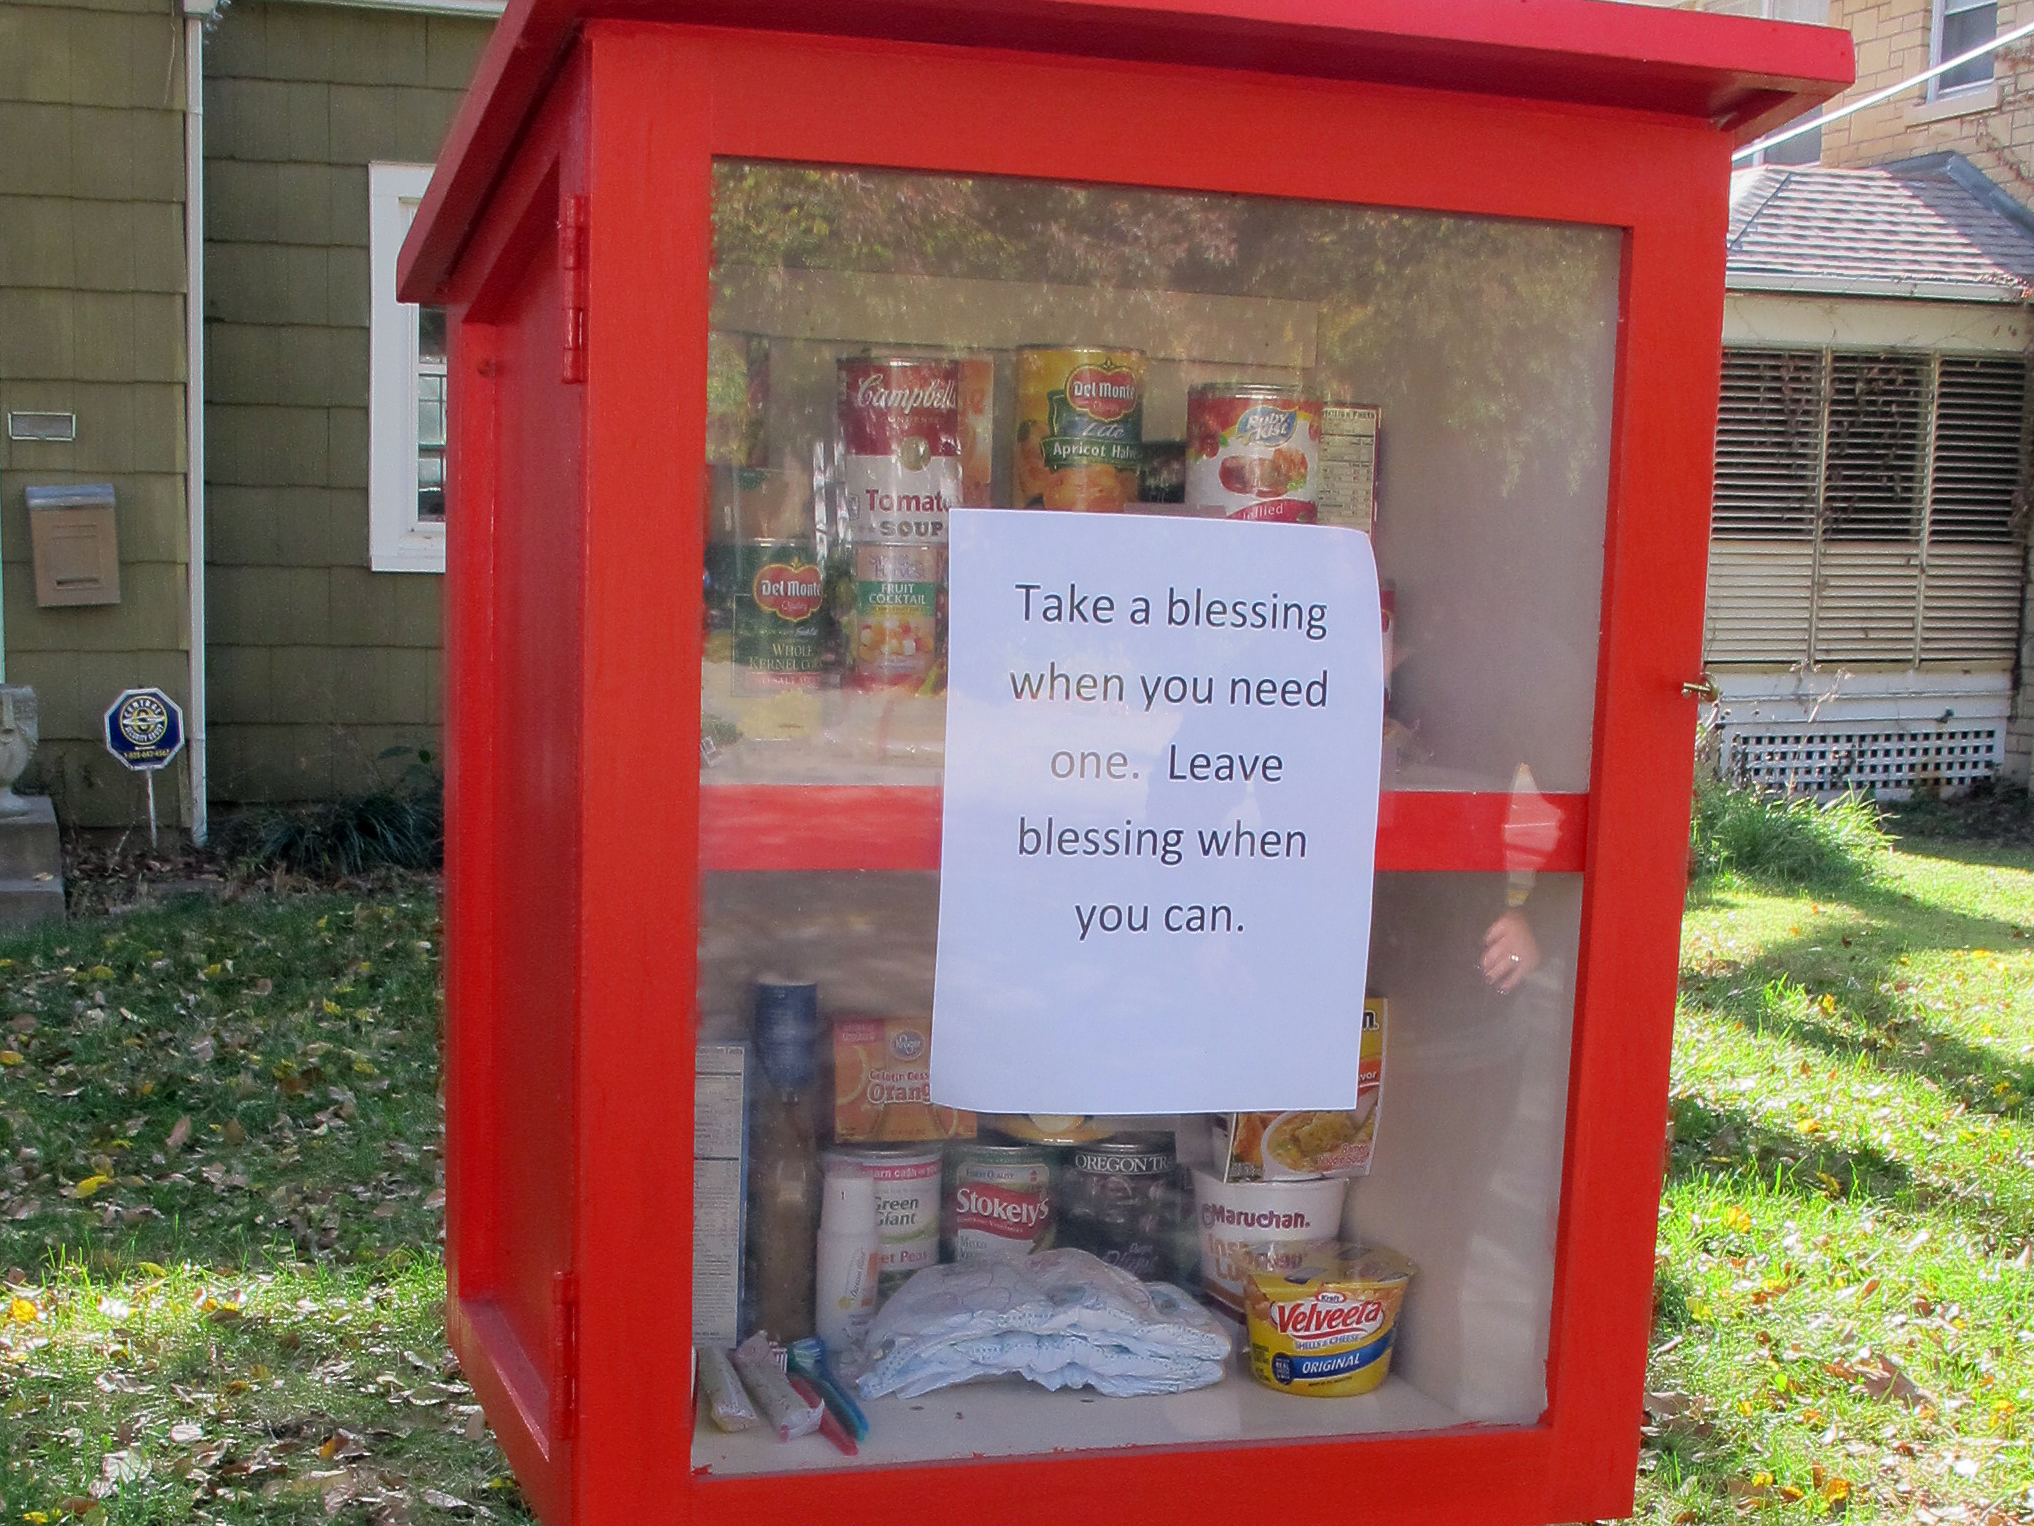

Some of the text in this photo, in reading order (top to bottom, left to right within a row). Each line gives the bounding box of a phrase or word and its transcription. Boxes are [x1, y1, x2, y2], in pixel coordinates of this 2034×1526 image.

[1073, 381, 1135, 399] Del Monte
[1053, 441, 1107, 458] Apricot
[879, 521, 944, 537] SOUP
[761, 580, 821, 597] Del Monte
[881, 583, 915, 594] FRUIT
[868, 593, 926, 605] COCKTAIL
[1015, 583, 1328, 641] Take a blessing
[1010, 661, 1328, 713] when you need
[1051, 744, 1284, 783] one. Leave
[1019, 816, 1307, 866] blessing when
[1074, 903, 1244, 942] you can.
[869, 1068, 904, 1082] Gelatin
[1357, 1071, 1377, 1082] vor
[1075, 1154, 1147, 1172] OREGON
[875, 1196, 919, 1211] Green
[956, 1187, 1049, 1227] Stokely's
[1321, 1293, 1341, 1301] Kraft
[1277, 1300, 1381, 1333] Velveeta
[1302, 1353, 1361, 1374] ORIGINAL
